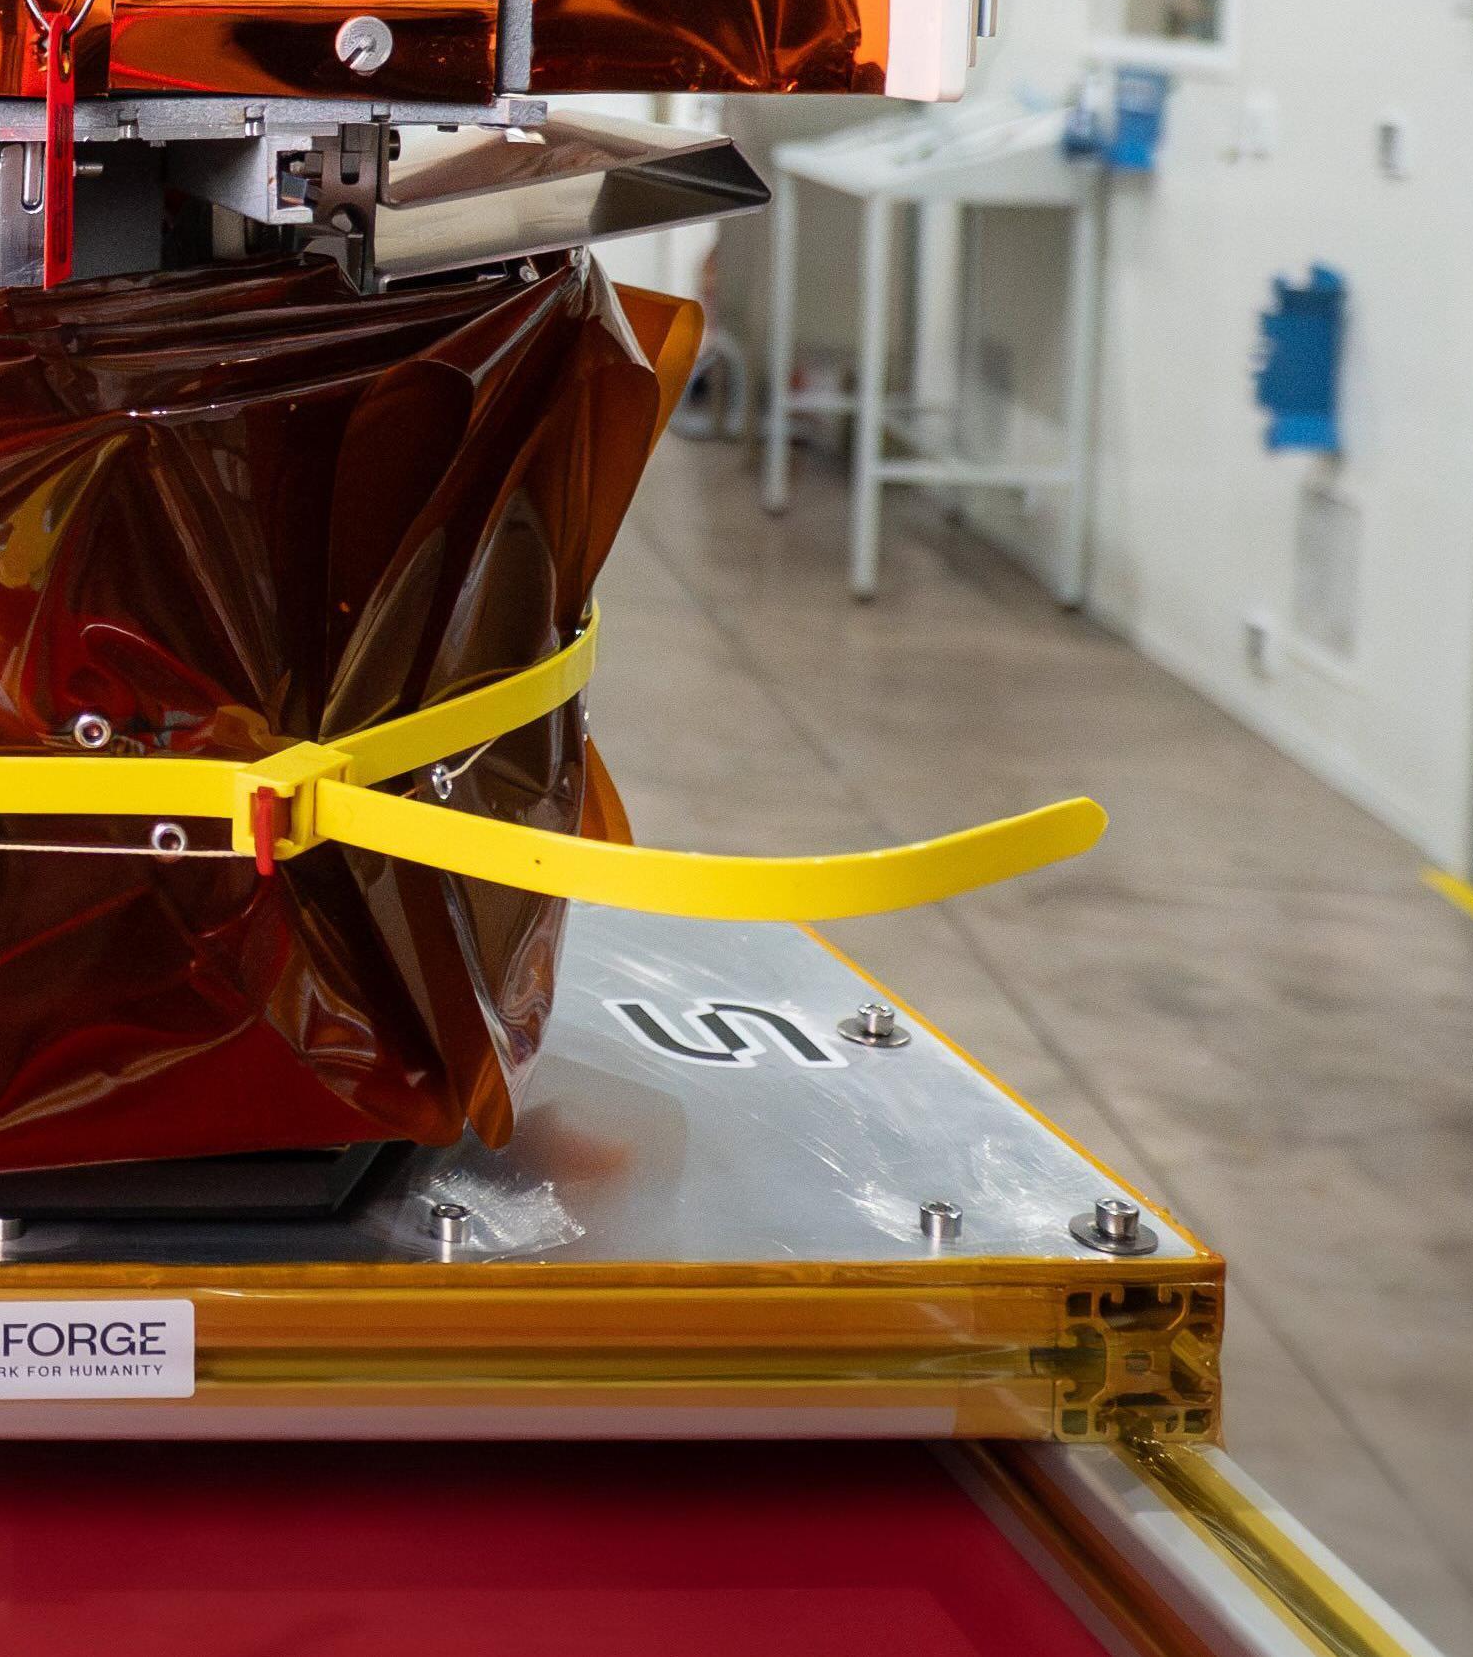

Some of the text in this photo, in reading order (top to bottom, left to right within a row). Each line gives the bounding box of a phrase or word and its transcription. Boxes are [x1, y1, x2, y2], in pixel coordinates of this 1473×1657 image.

[3, 1321, 167, 1357] FORGE
[27, 1364, 62, 1377] FOR
[69, 1363, 164, 1378] HUMANITY
